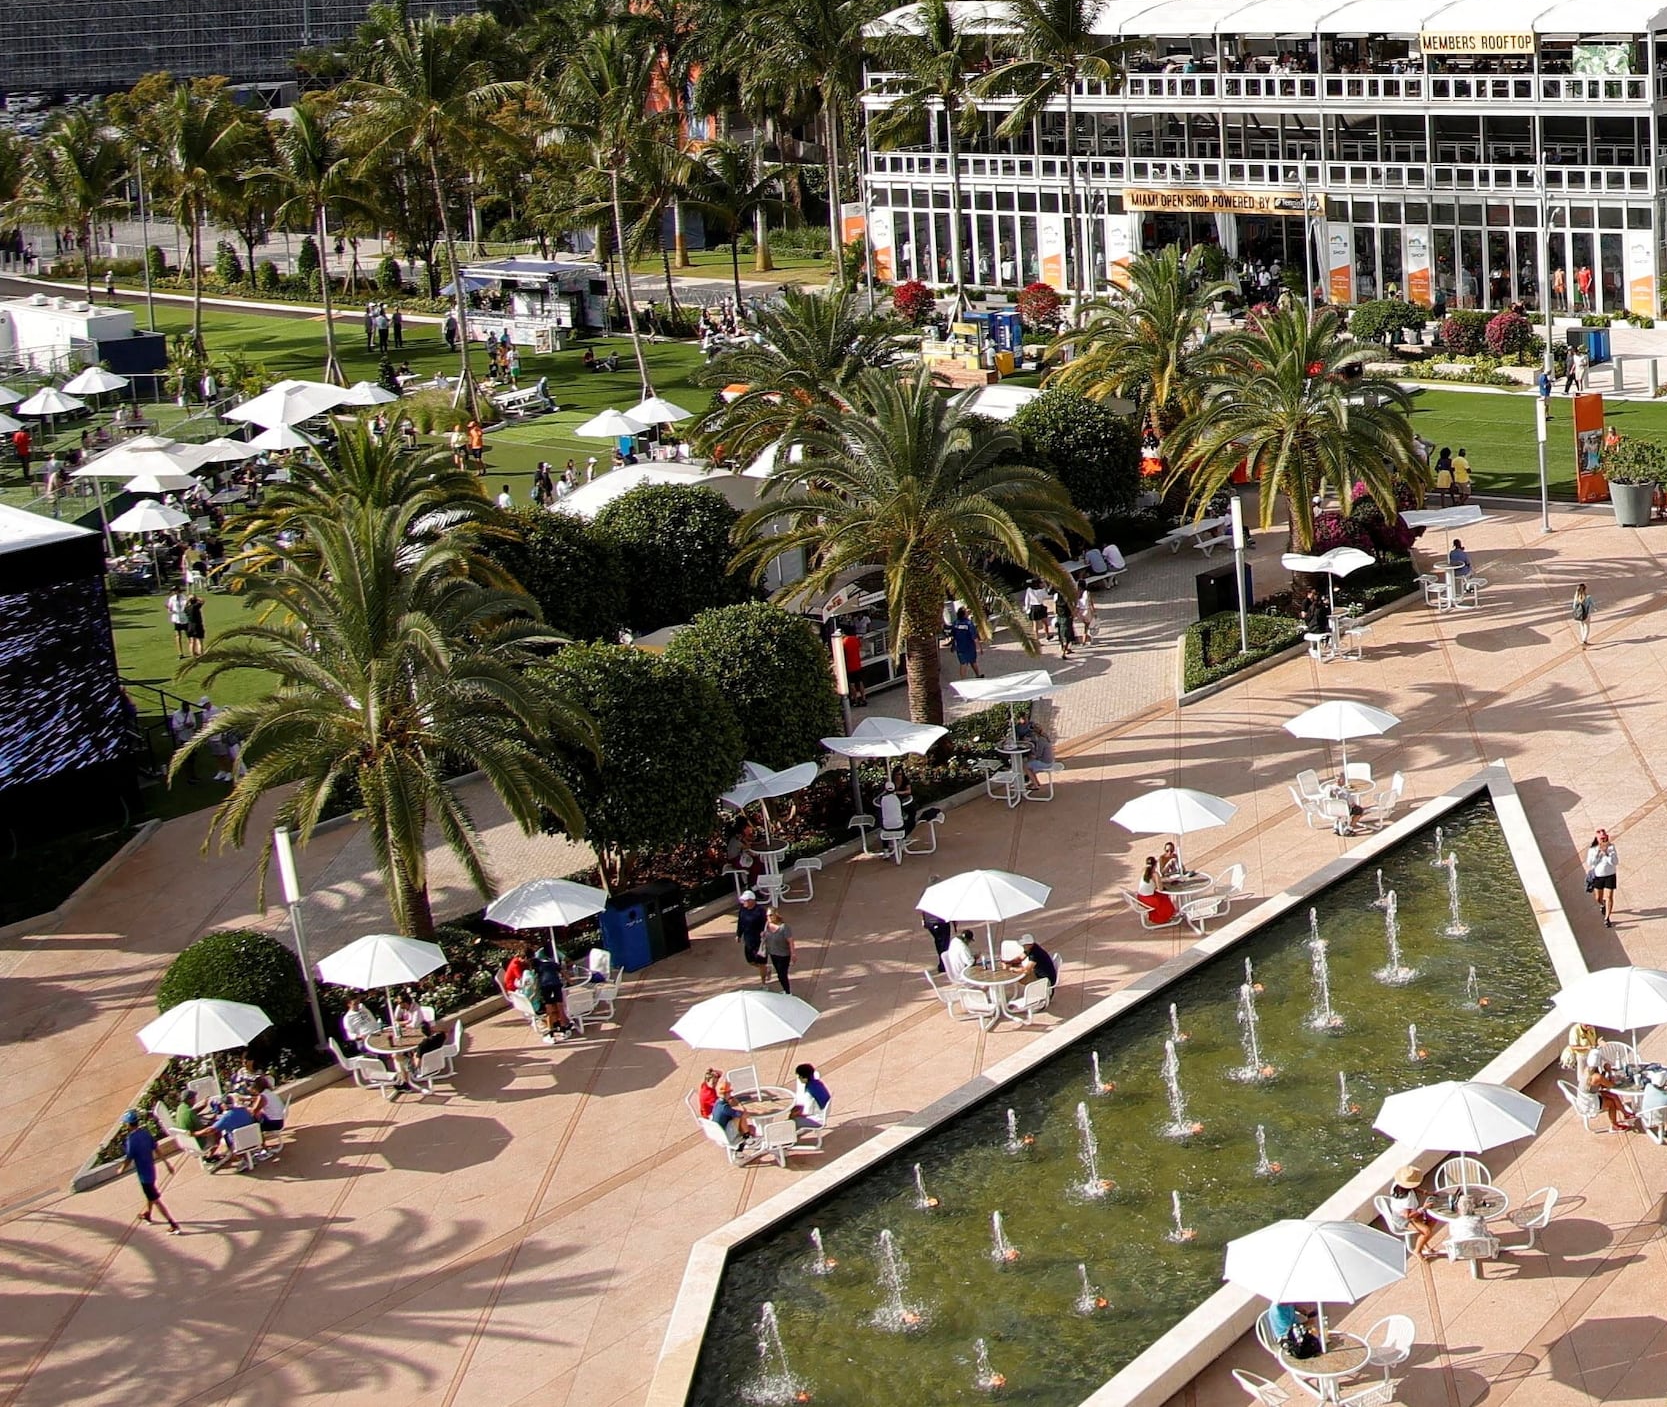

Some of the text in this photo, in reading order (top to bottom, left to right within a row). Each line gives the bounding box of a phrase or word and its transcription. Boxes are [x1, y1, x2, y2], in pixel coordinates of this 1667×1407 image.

[1422, 33, 1533, 52] MEMBERS ROOFTOP
[1131, 194, 1270, 210] MIAMI OPEN SHOP POWERED BY
